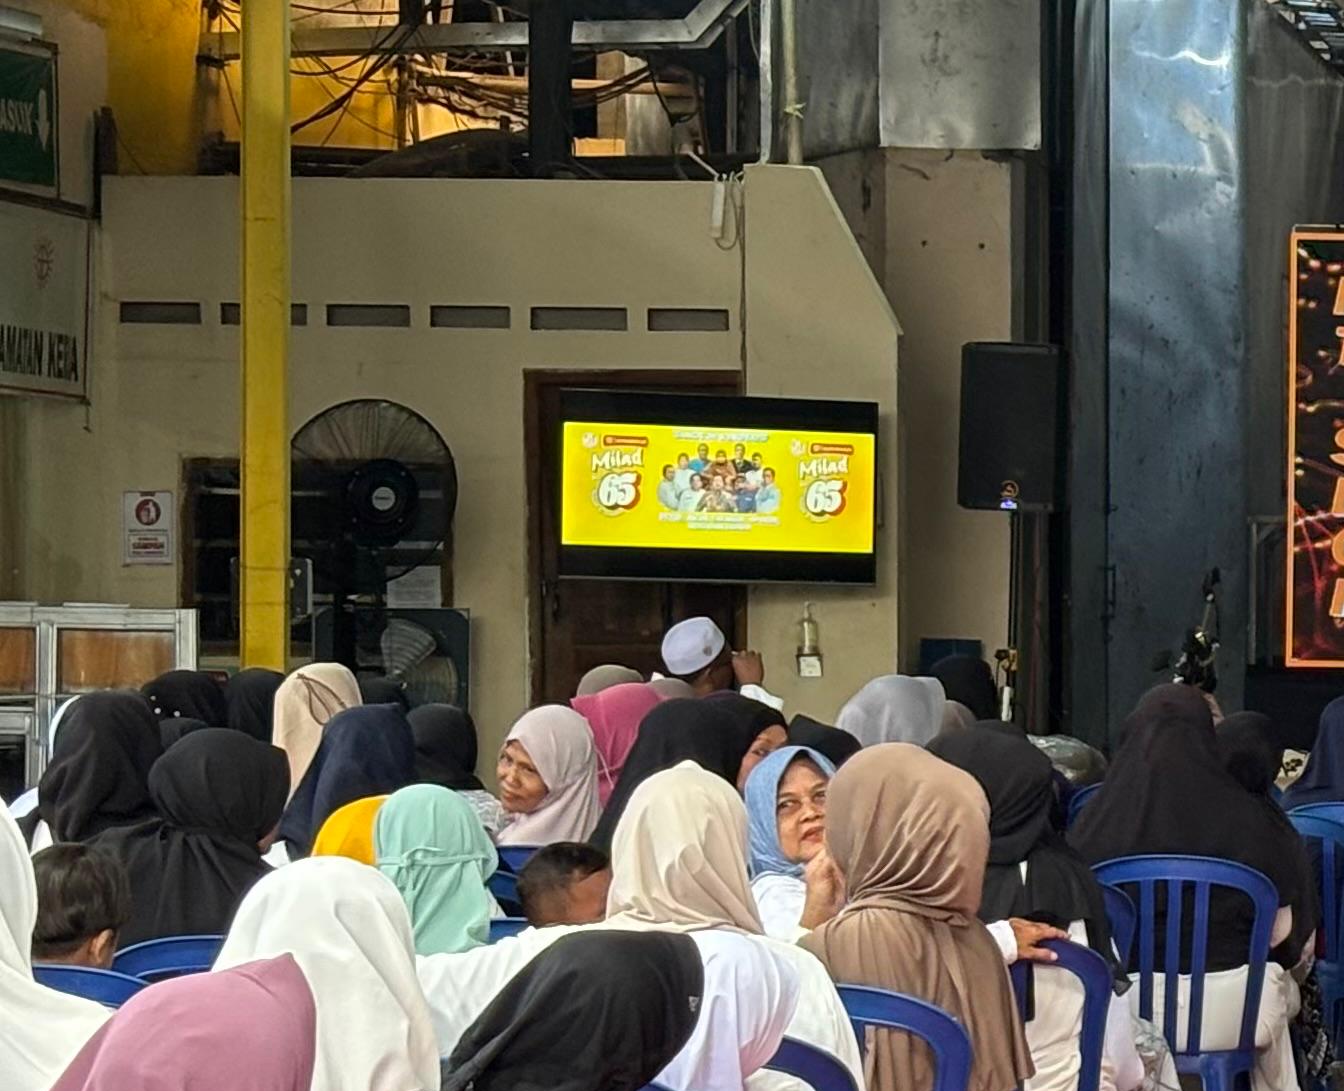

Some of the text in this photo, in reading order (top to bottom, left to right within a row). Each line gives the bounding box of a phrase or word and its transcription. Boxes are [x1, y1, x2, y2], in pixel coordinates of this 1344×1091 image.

[0, 98, 33, 136] ASUK
[591, 448, 644, 472] Milad
[799, 456, 850, 479] Milad
[597, 472, 639, 510] 65
[805, 479, 845, 517] 65
